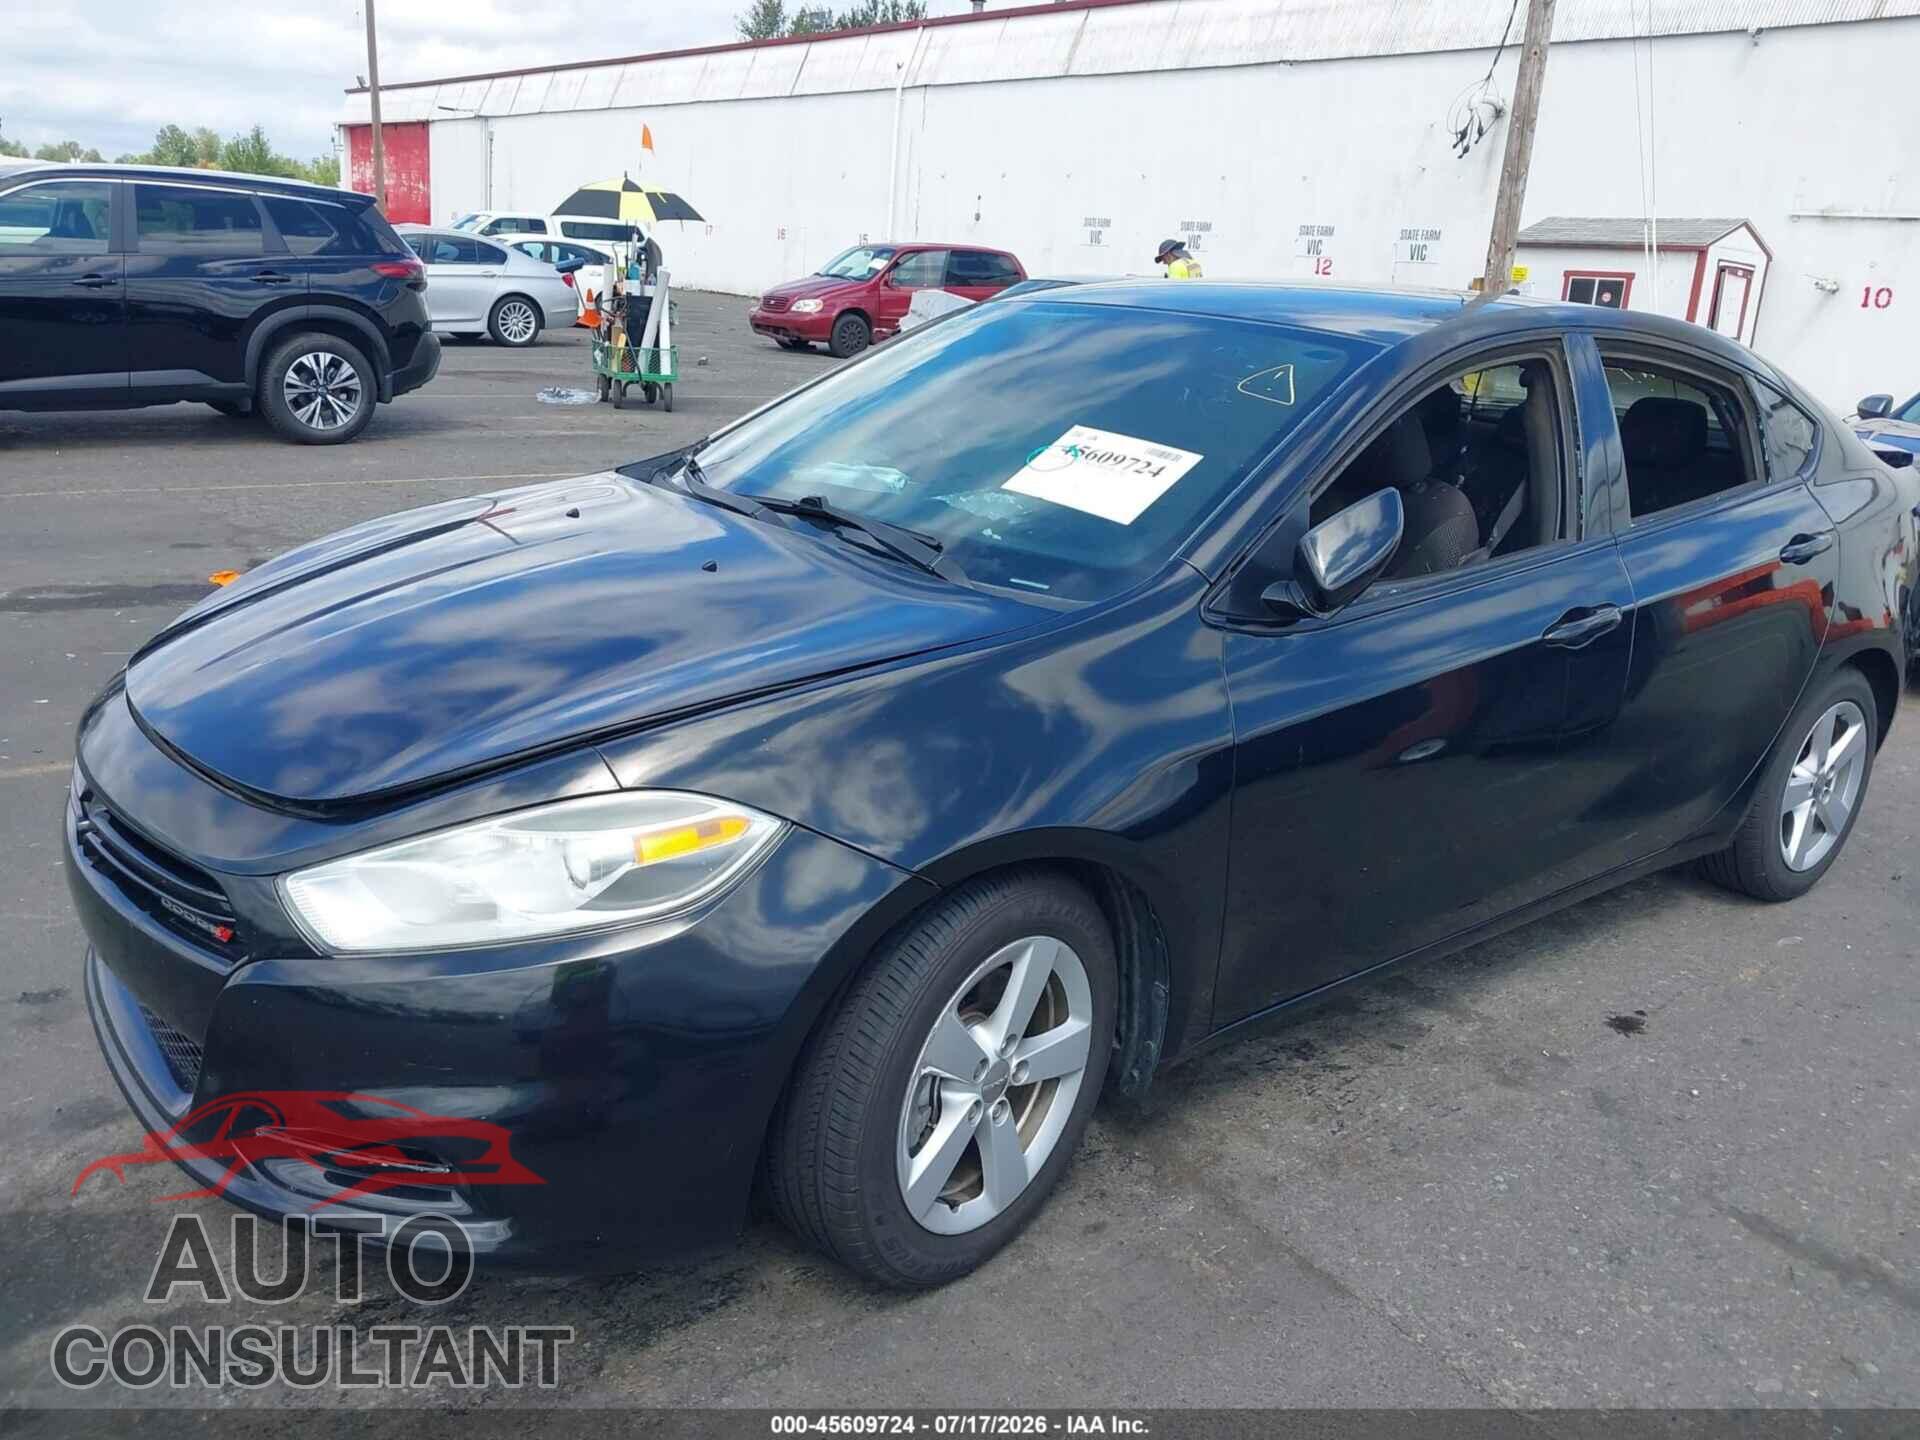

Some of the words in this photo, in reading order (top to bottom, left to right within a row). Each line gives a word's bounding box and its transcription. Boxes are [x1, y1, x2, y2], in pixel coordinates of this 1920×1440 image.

[1180, 220, 1196, 231] STATE
[1299, 225, 1315, 236] STATE
[1316, 225, 1335, 237] FARM
[1090, 230, 1102, 244] VIC
[1188, 234, 1201, 249] VIC
[1400, 229, 1420, 241] STATE
[1420, 229, 1441, 241] FARM
[1306, 239, 1323, 255] VIC
[1409, 244, 1427, 261] VIC
[1314, 257, 1333, 275] 12
[1861, 286, 1893, 308] 10
